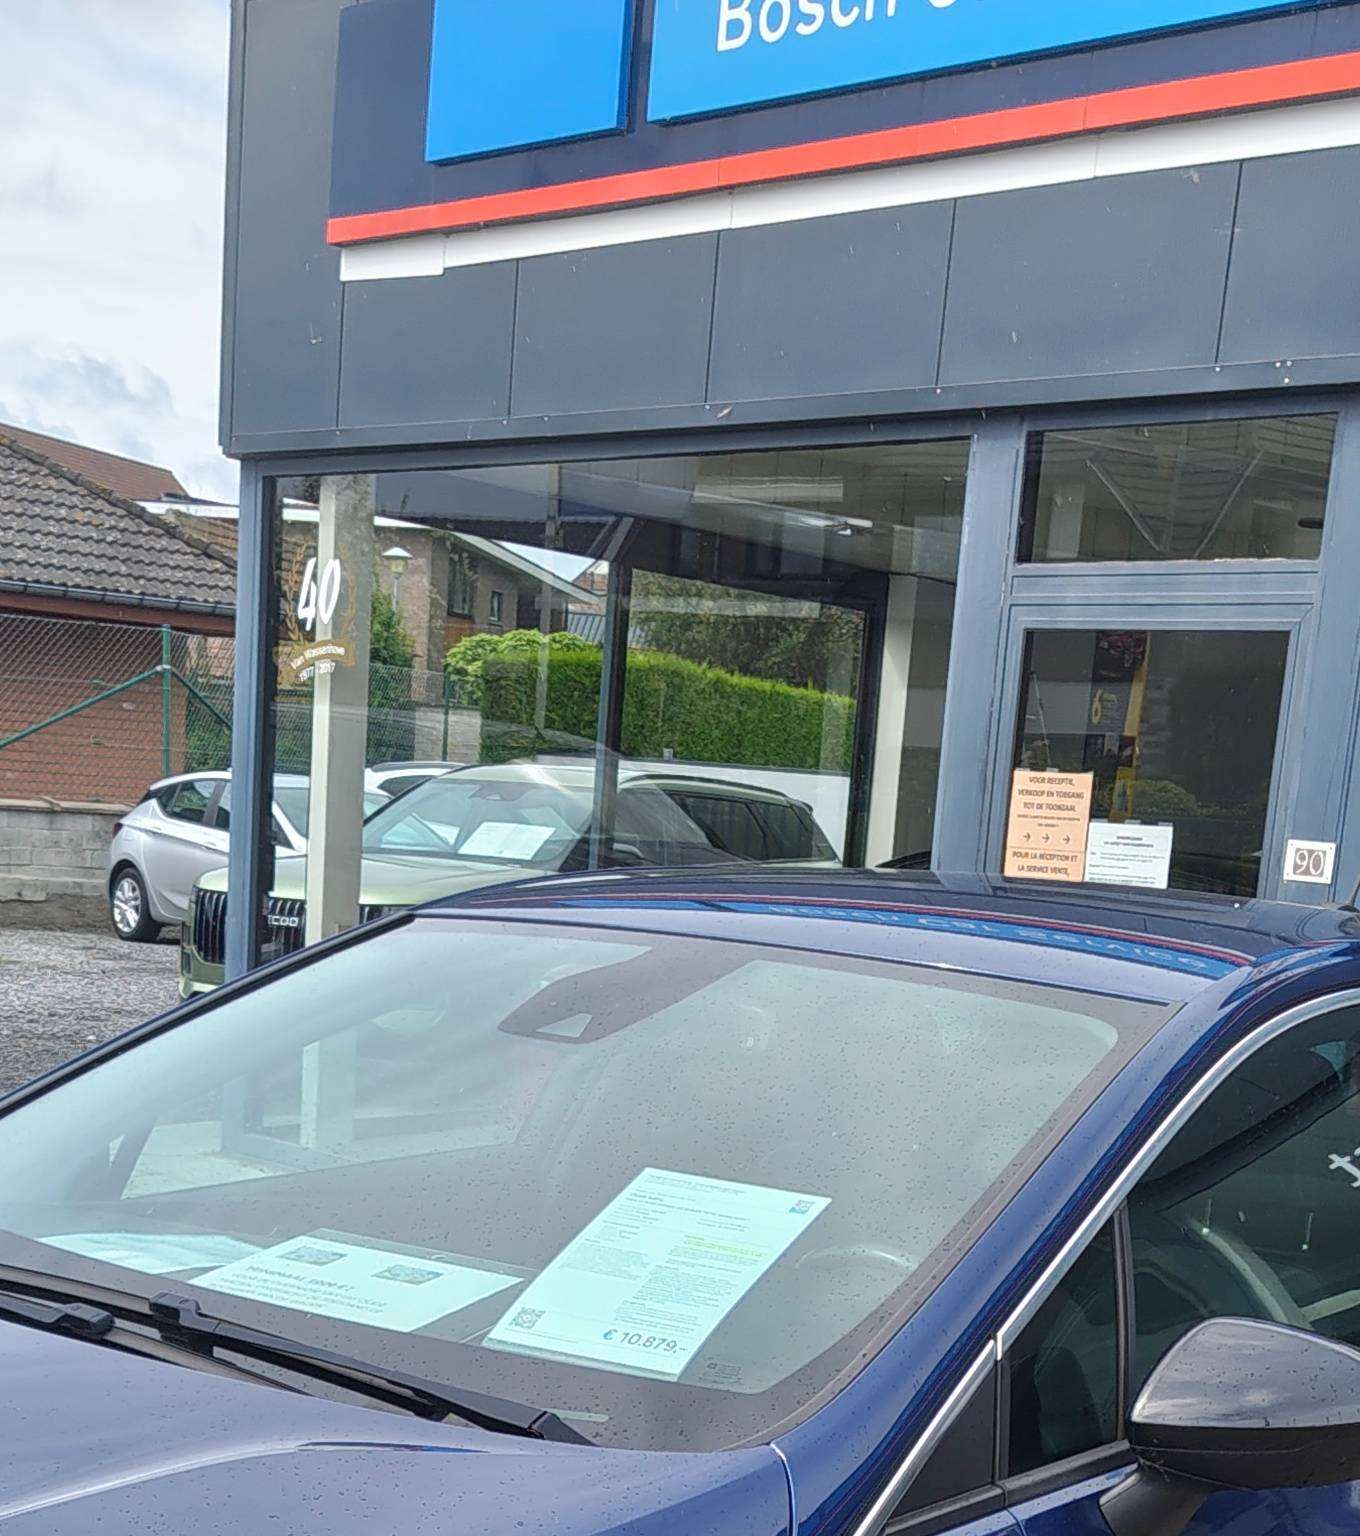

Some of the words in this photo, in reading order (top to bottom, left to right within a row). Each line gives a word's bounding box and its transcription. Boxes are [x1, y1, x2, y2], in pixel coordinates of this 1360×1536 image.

[716, 0, 898, 52] Bosc
[297, 556, 341, 631] 40
[1296, 850, 1324, 875] 90
[602, 1328, 618, 1342] €
